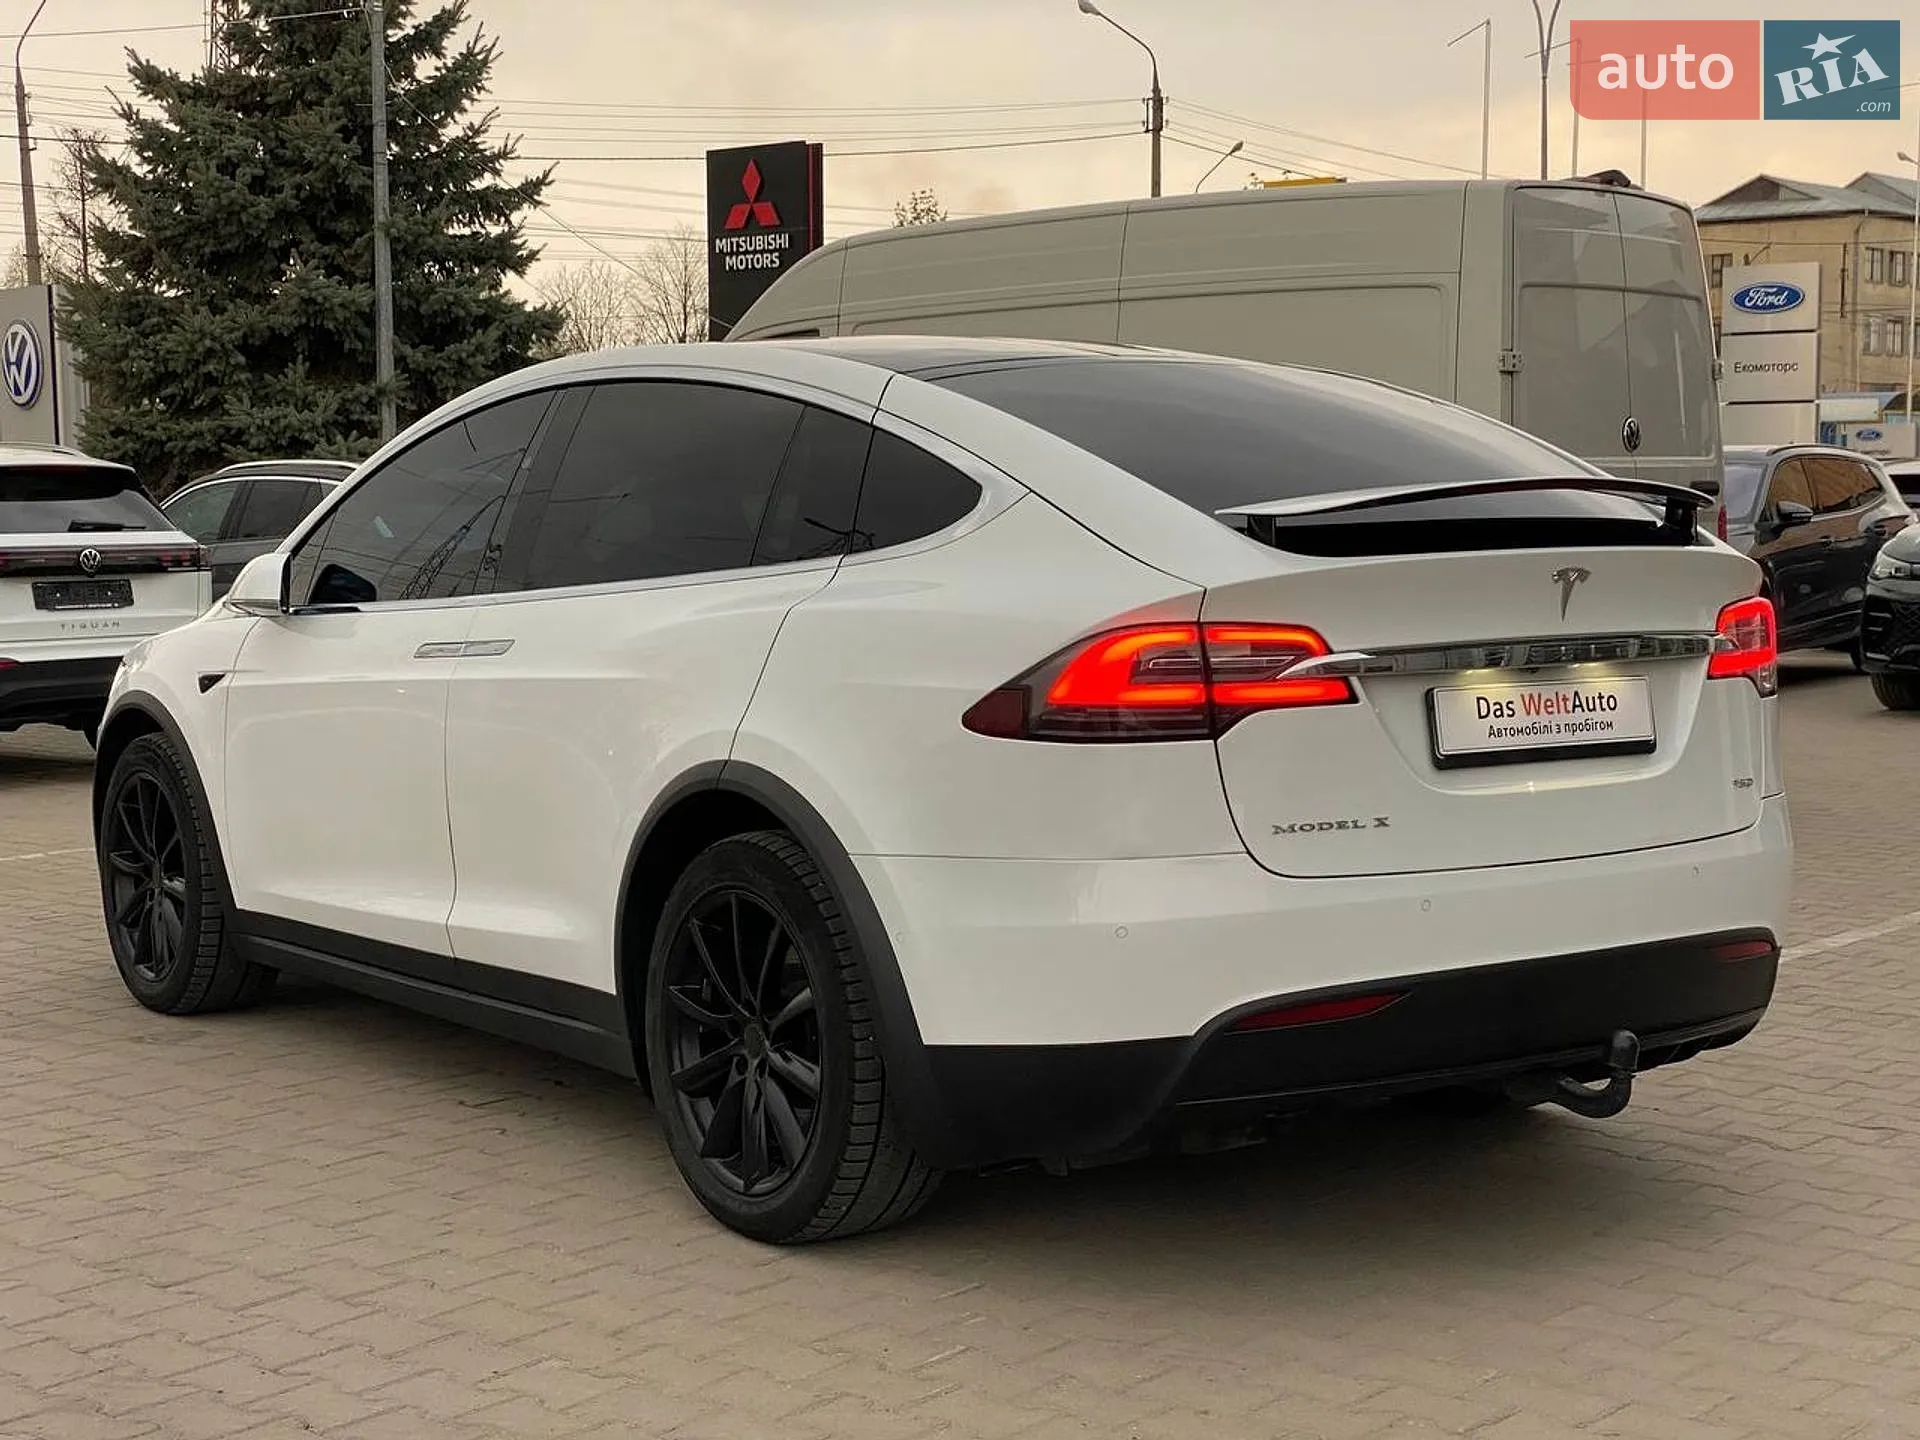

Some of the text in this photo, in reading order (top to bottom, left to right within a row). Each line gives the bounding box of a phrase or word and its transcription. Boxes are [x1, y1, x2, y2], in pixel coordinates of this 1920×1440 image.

[715, 233, 789, 254] MITSUBISHI
[725, 252, 780, 271] MOTORS
[1744, 287, 1789, 307] Ford
[1734, 361, 1799, 374] Екомоторс
[60, 621, 120, 631] TIGUAN
[1476, 691, 1618, 720] Das WeltAuto
[1488, 717, 1614, 739] Автомобілі з пробігом
[1272, 817, 1391, 835] MODEL X
